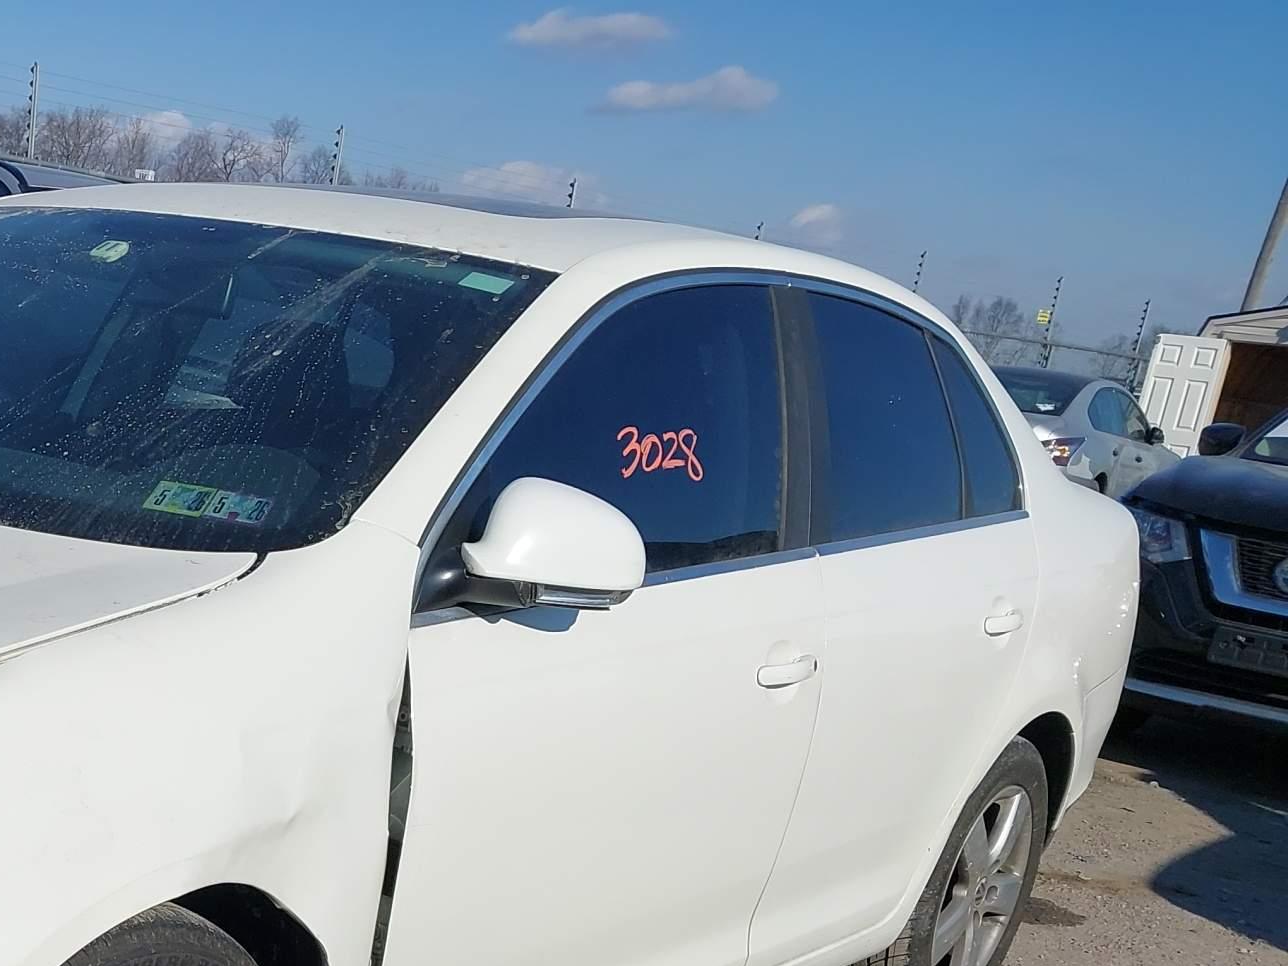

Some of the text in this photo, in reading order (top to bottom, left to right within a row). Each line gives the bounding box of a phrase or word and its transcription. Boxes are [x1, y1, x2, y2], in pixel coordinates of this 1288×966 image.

[616, 426, 704, 482] 3028
[153, 489, 170, 506] 5
[212, 496, 230, 514] 5
